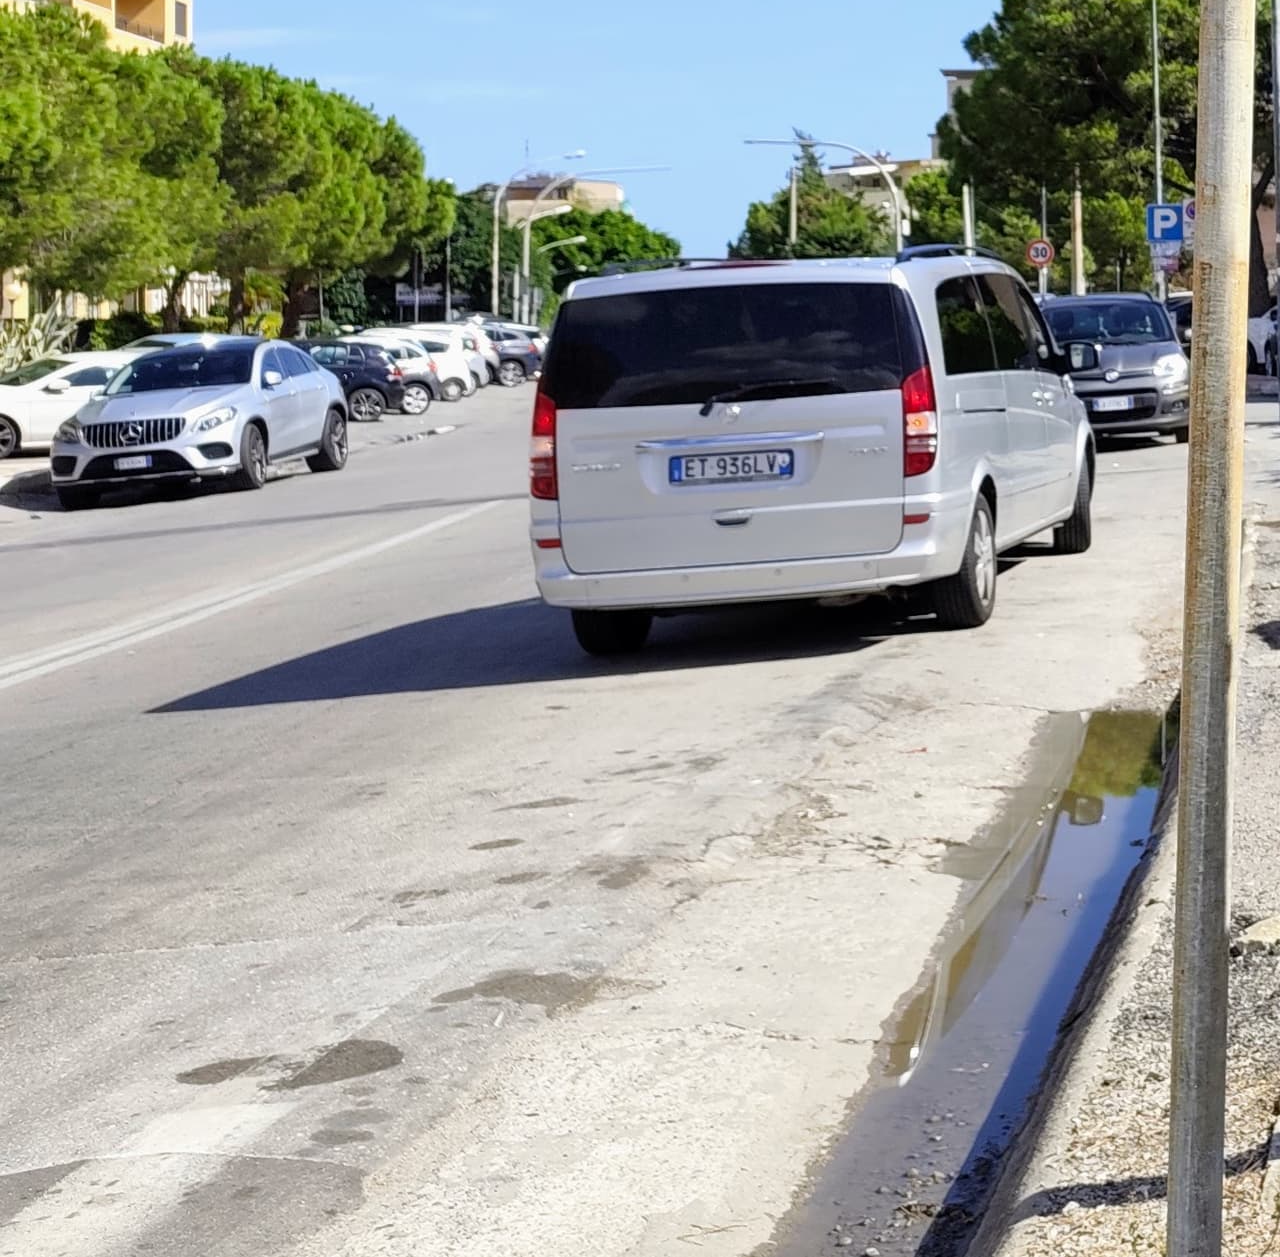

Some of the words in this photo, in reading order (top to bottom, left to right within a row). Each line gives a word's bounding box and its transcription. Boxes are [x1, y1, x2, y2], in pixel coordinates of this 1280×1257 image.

[1153, 208, 1178, 239] P
[1032, 246, 1048, 260] 30
[685, 458, 708, 478] ET
[716, 454, 777, 476] 936LV
